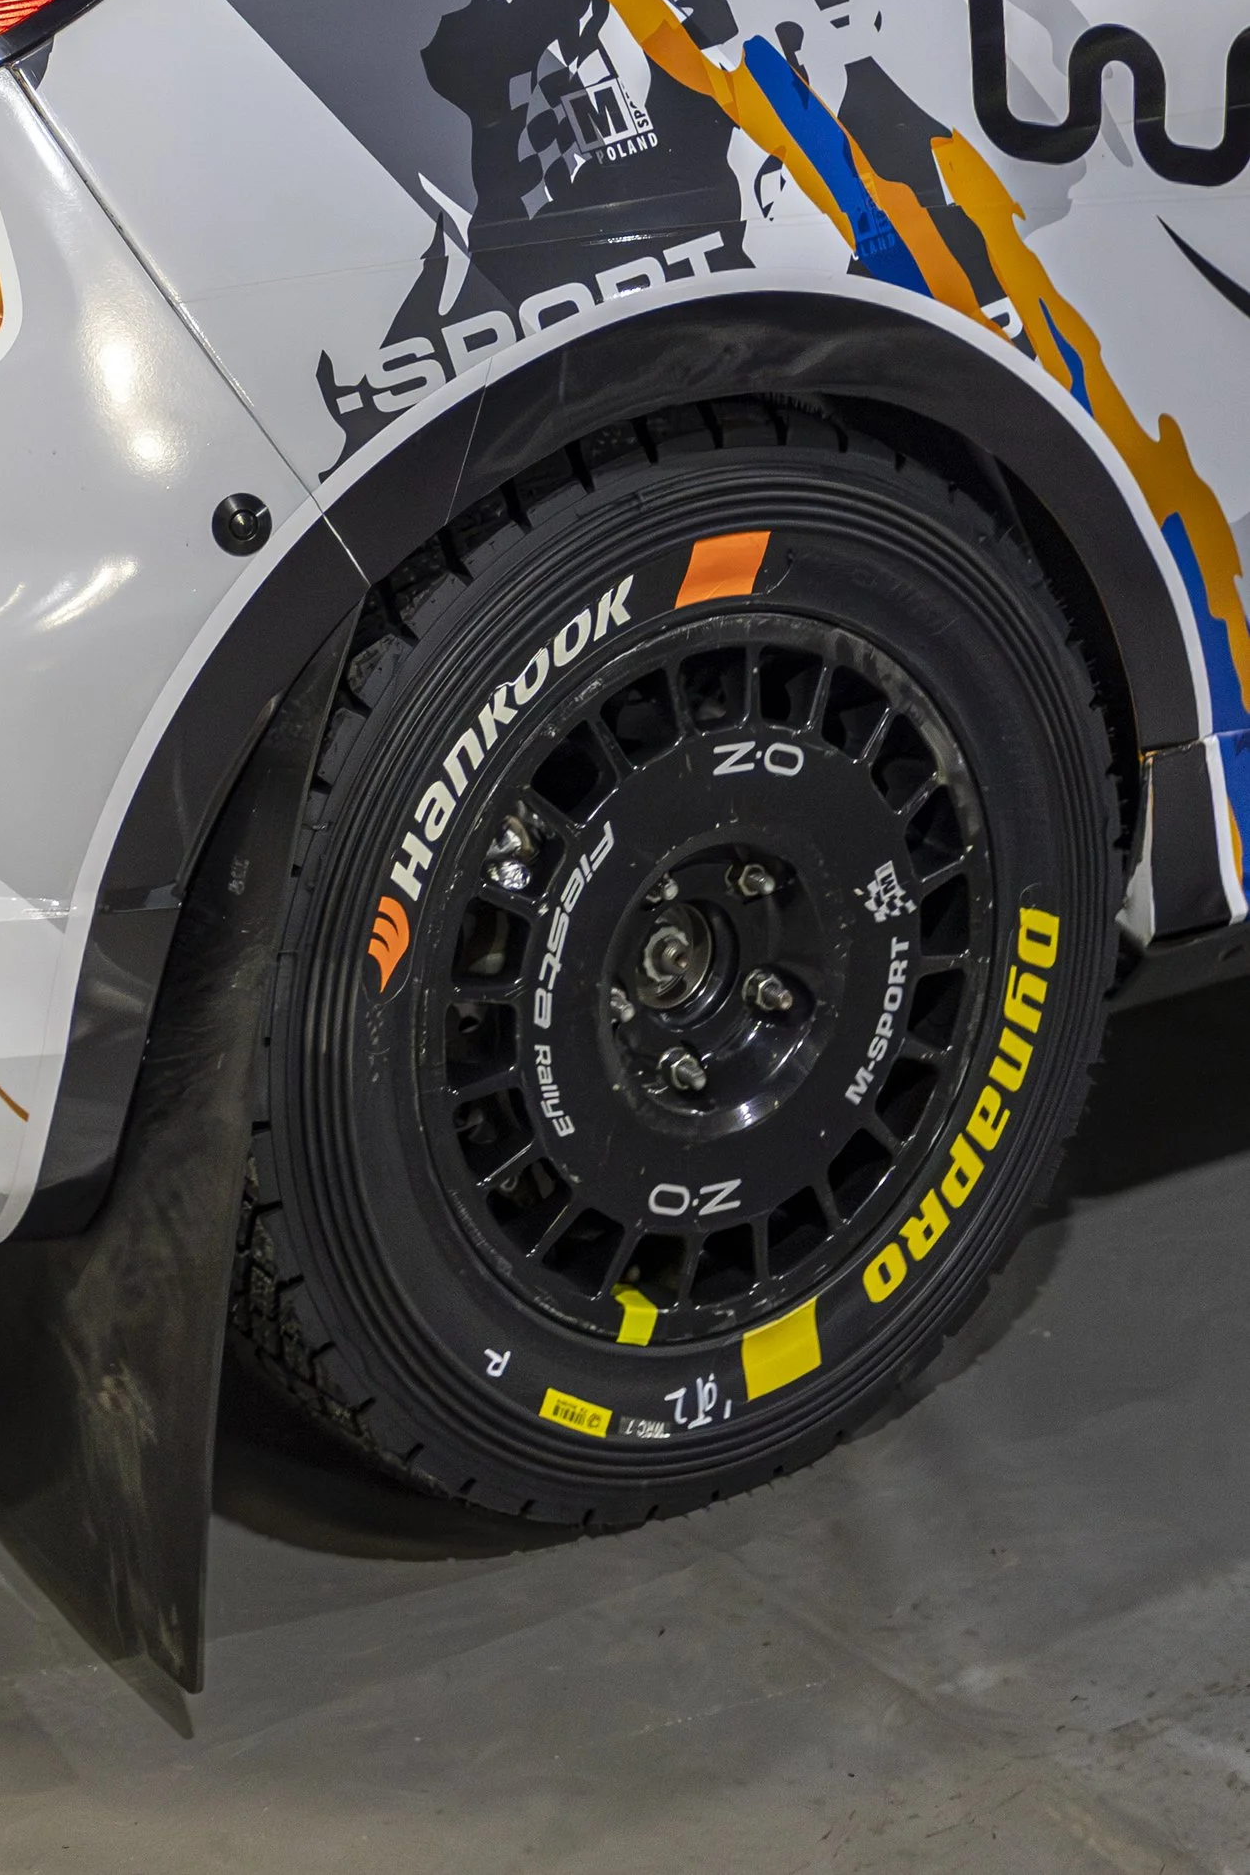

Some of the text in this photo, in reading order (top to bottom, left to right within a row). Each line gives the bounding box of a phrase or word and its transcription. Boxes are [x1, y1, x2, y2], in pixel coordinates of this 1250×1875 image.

[595, 132, 659, 165] POLAND
[844, 935, 910, 1107] M-SPORT
[532, 1042, 576, 1139] Rally3
